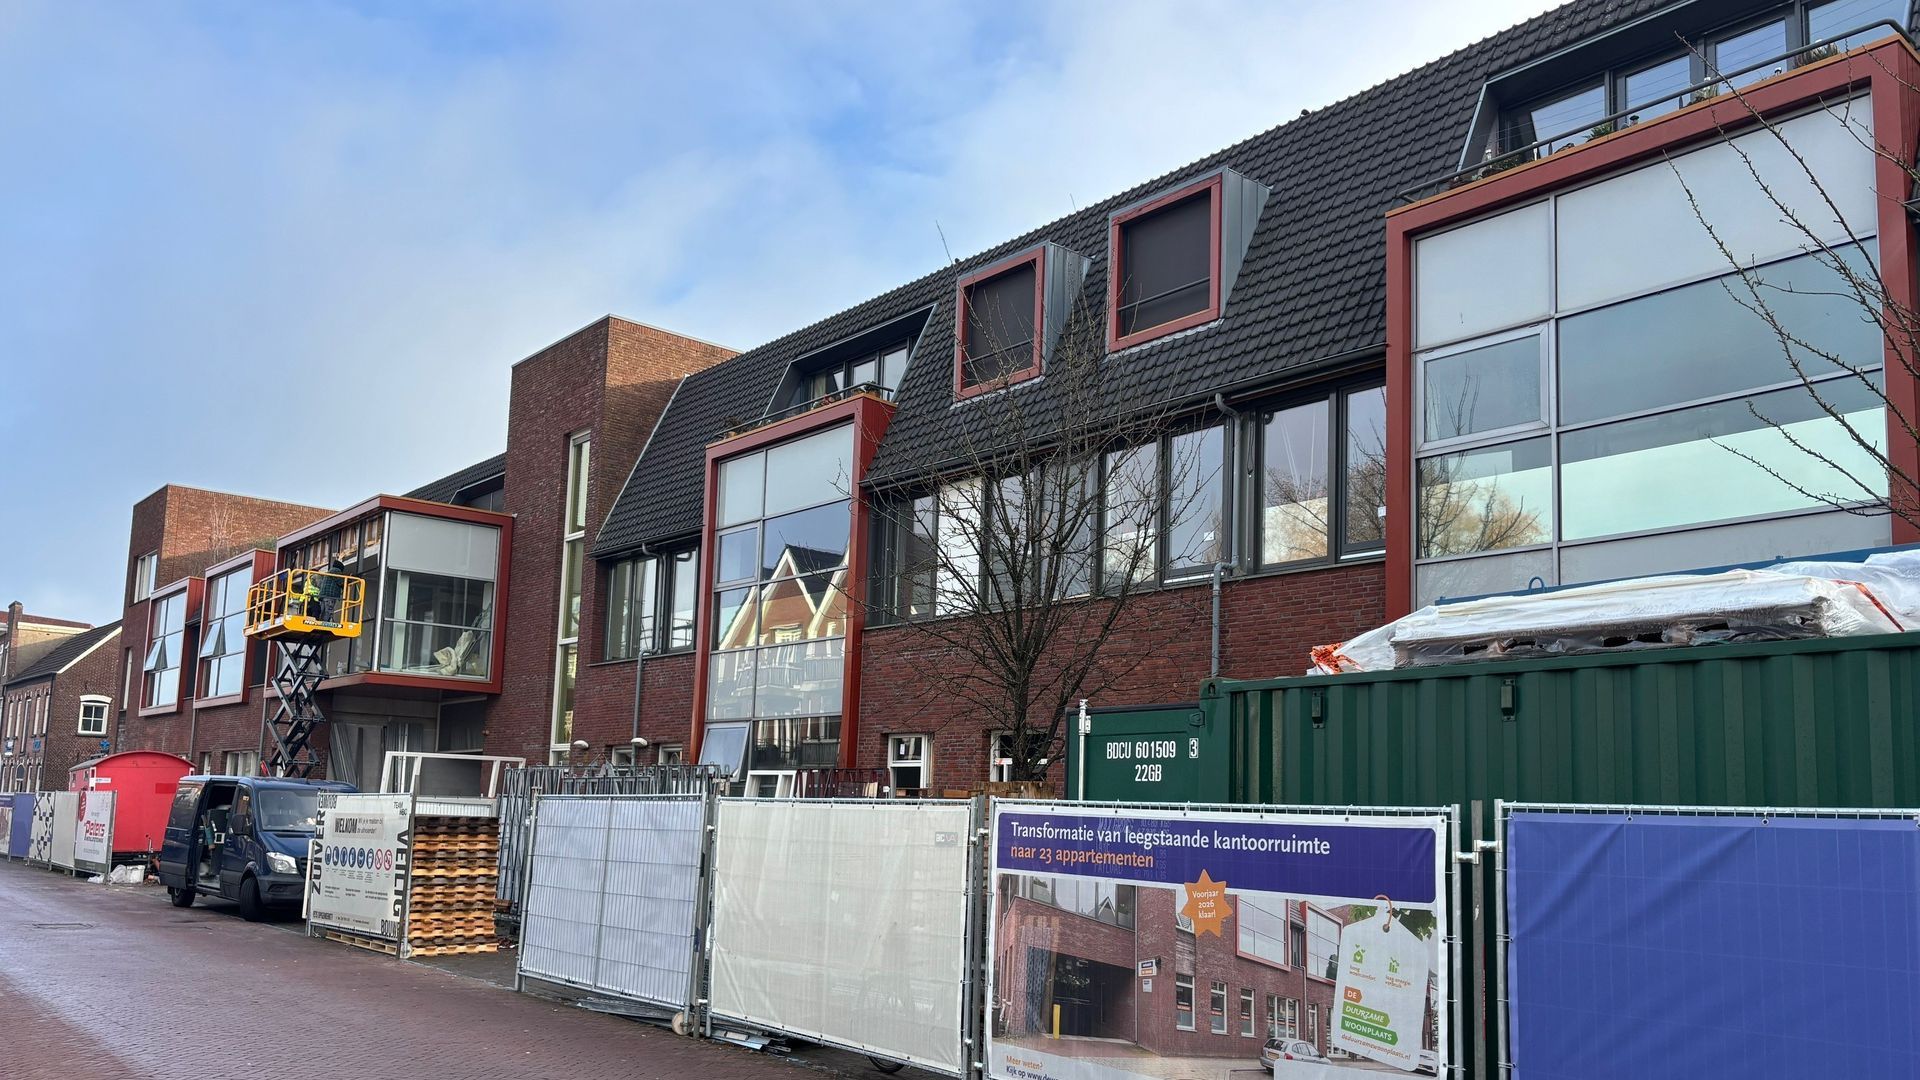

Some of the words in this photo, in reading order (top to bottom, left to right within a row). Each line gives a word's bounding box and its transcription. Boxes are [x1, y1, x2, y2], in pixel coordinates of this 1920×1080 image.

[1106, 741, 1132, 759] BDCU
[1135, 740, 1177, 759] 601509
[1190, 739, 1198, 757] 3
[1134, 764, 1162, 782] 22GB
[335, 817, 358, 833] WELKOM
[1011, 821, 1094, 842] Transformatie
[1097, 830, 1121, 843] van
[1125, 825, 1209, 850] leegstaande
[1214, 829, 1331, 855] kantoorruimte
[312, 810, 326, 895] ZUIVER
[1010, 844, 1037, 859] naar
[1039, 848, 1052, 864] 23
[1055, 849, 1154, 868] appartementen
[393, 829, 409, 917] VEILIG
[1191, 889, 1219, 900] Voorjaar
[1198, 900, 1215, 909] 2026
[1198, 910, 1216, 919] klaar!
[1347, 990, 1358, 999] DE
[1345, 1005, 1385, 1022] DUURZAME
[1344, 1020, 1393, 1041] WOONPLAATS
[1006, 1055, 1021, 1065] Meer
[1006, 1065, 1017, 1076] Kijk
[1018, 1070, 1026, 1079] op
